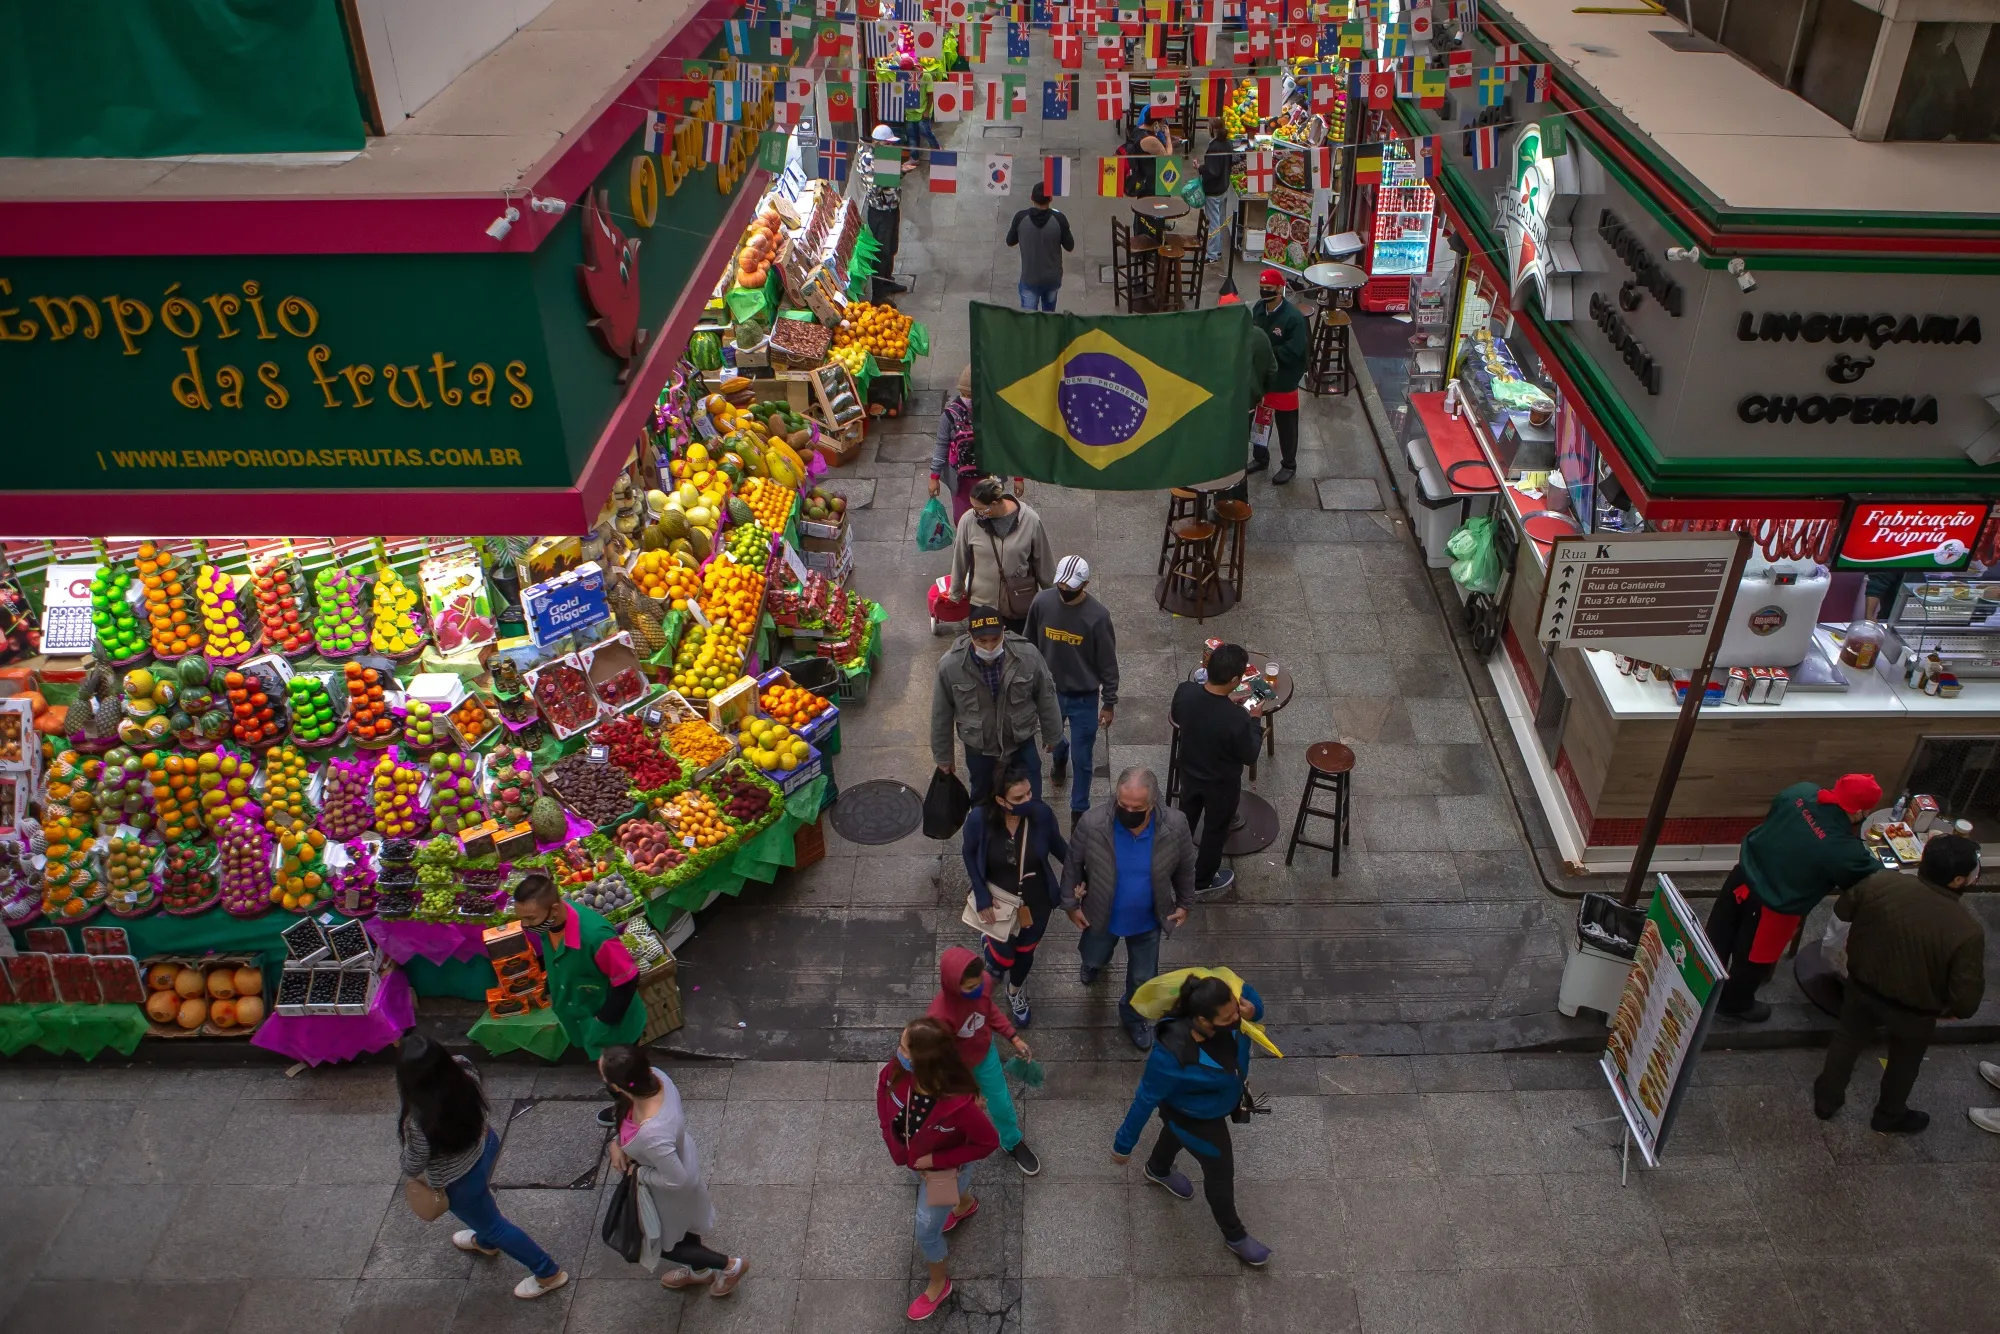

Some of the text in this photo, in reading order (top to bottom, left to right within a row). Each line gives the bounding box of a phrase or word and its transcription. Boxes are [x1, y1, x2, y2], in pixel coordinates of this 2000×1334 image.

[1516, 203, 1545, 249] CALLANI
[0, 278, 320, 355] Empório
[1736, 310, 1982, 351] LINGUIÇARIA
[171, 343, 535, 410] das frutas
[1824, 352, 1876, 384] &
[1098, 379, 1146, 404] PROGRESSO
[1736, 392, 1939, 425] CHOPERIA
[111, 447, 524, 469] WWW.EMPORIODASFRUTAS.COM.BR
[1862, 510, 1975, 530] Fabricação
[1870, 527, 1948, 547] Própria
[1560, 544, 1613, 559] Rua K
[1591, 566, 1620, 575] Frutas
[1587, 580, 1666, 591] Rua da Cantareira
[549, 596, 580, 616] Gold
[1584, 595, 1656, 605] Rua 25 de Março
[550, 602, 592, 626] Digger
[1581, 612, 1600, 621] Táxi
[48, 607, 58, 647] CHERRIES
[1045, 626, 1084, 646] PIRELLI
[1576, 627, 1604, 636] Sucos
[1801, 808, 1827, 841] CALLANI
